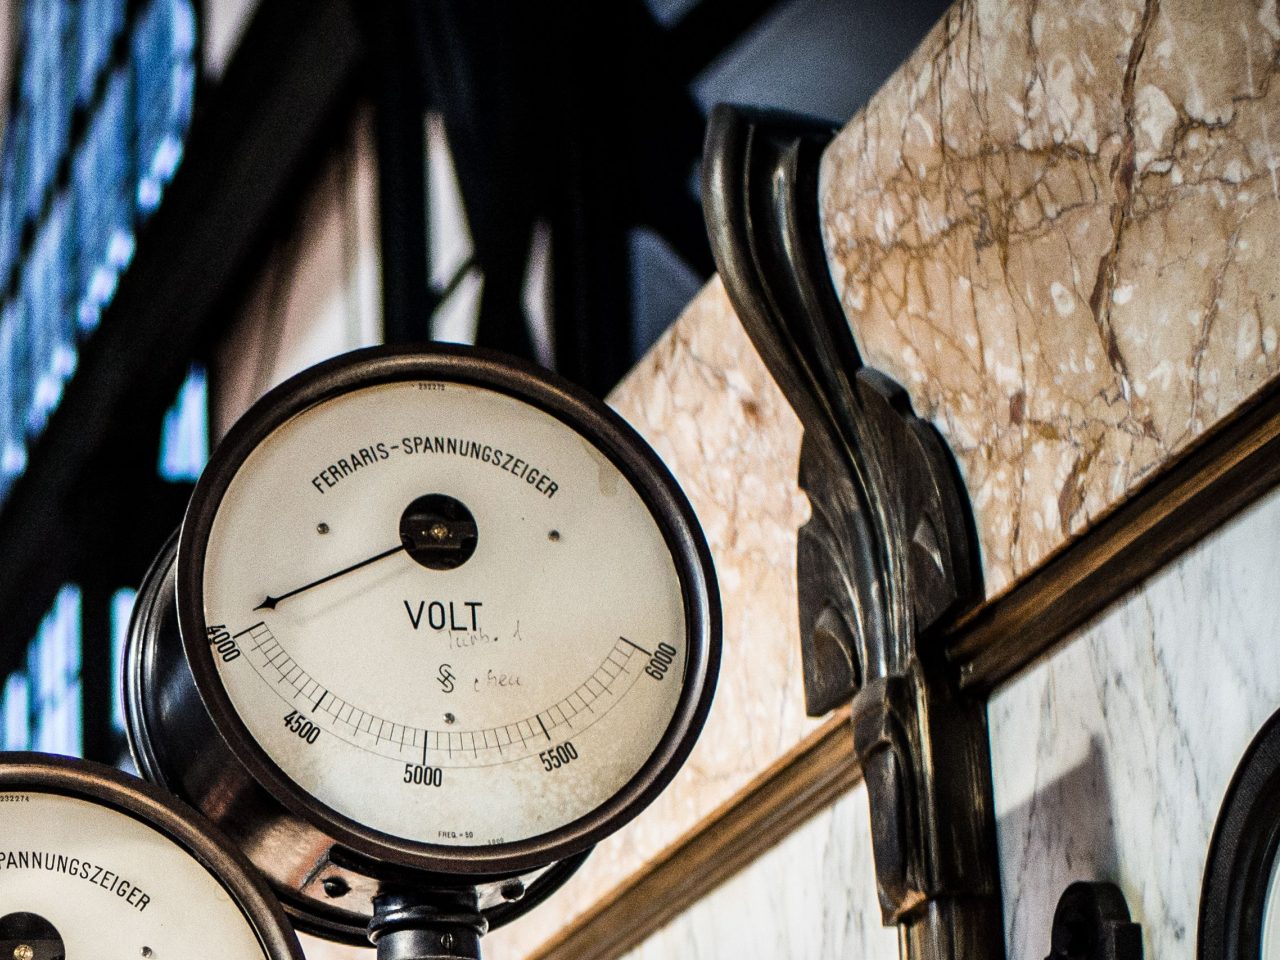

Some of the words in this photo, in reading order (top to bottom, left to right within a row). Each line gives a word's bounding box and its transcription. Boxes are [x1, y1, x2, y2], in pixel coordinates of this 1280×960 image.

[403, 600, 483, 631] VOLT
[207, 624, 241, 663] 4000
[645, 642, 677, 681] 6000
[283, 710, 321, 745] 4500
[539, 741, 579, 772] 5500
[403, 765, 443, 788] 5000
